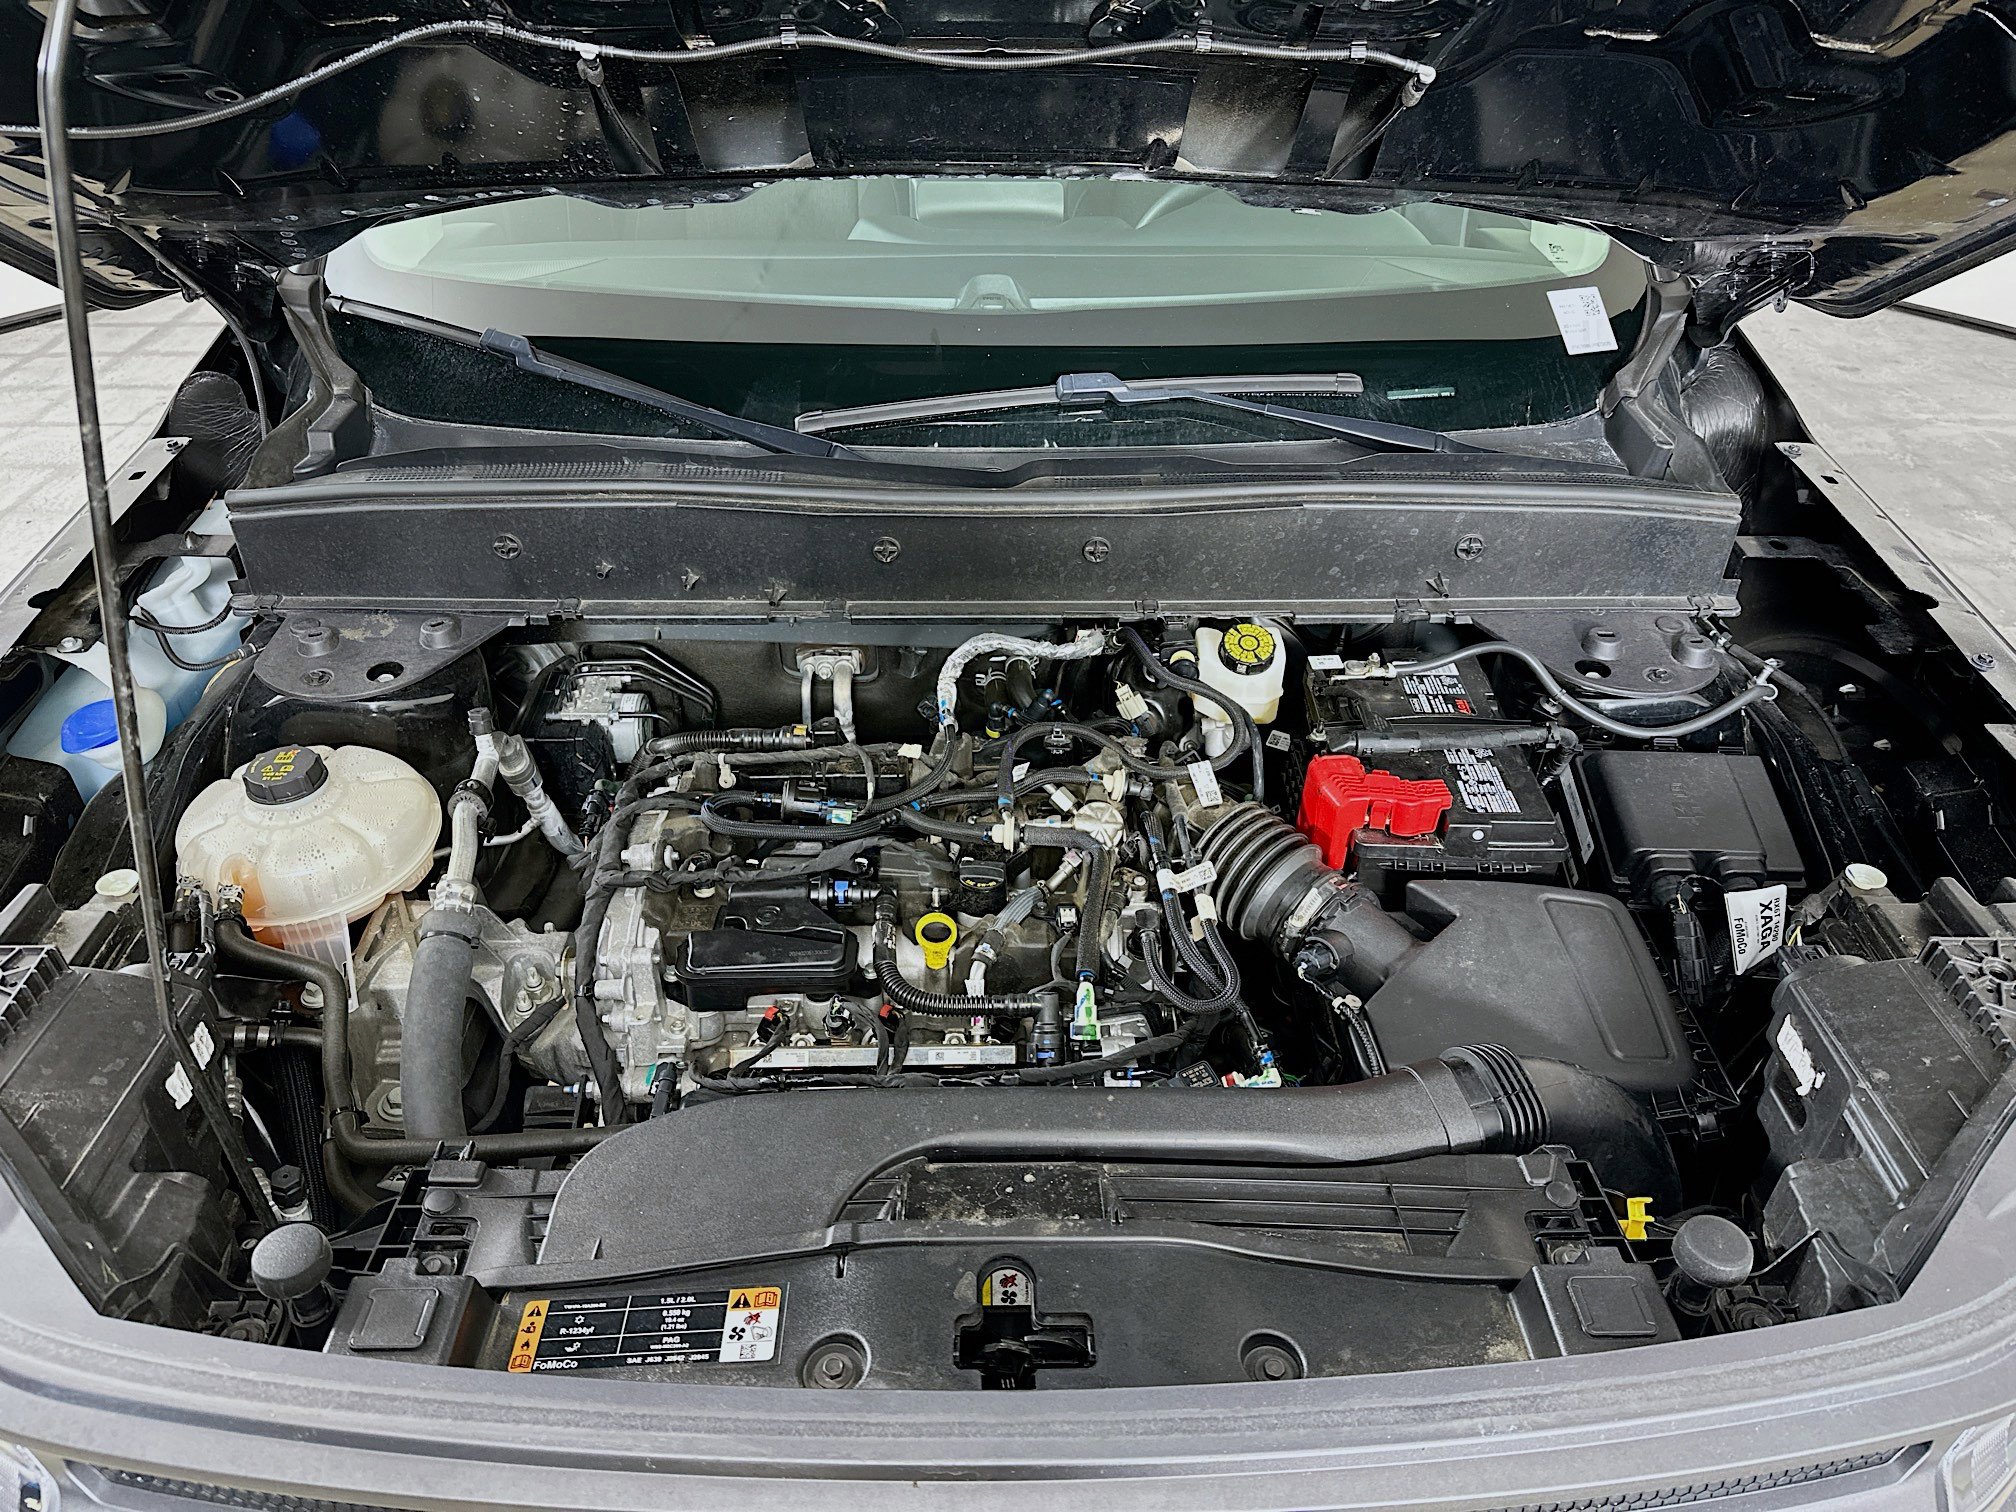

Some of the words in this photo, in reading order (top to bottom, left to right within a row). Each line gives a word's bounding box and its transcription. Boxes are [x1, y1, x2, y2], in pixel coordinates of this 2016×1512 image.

[1759, 900, 1773, 953] XAGA
[1734, 917, 1747, 955] FoMoCo
[681, 1309, 691, 1318] kg
[559, 1326, 595, 1336] R-1234yf
[662, 1336, 681, 1344] PAG
[532, 1359, 578, 1371] FoMoCo
